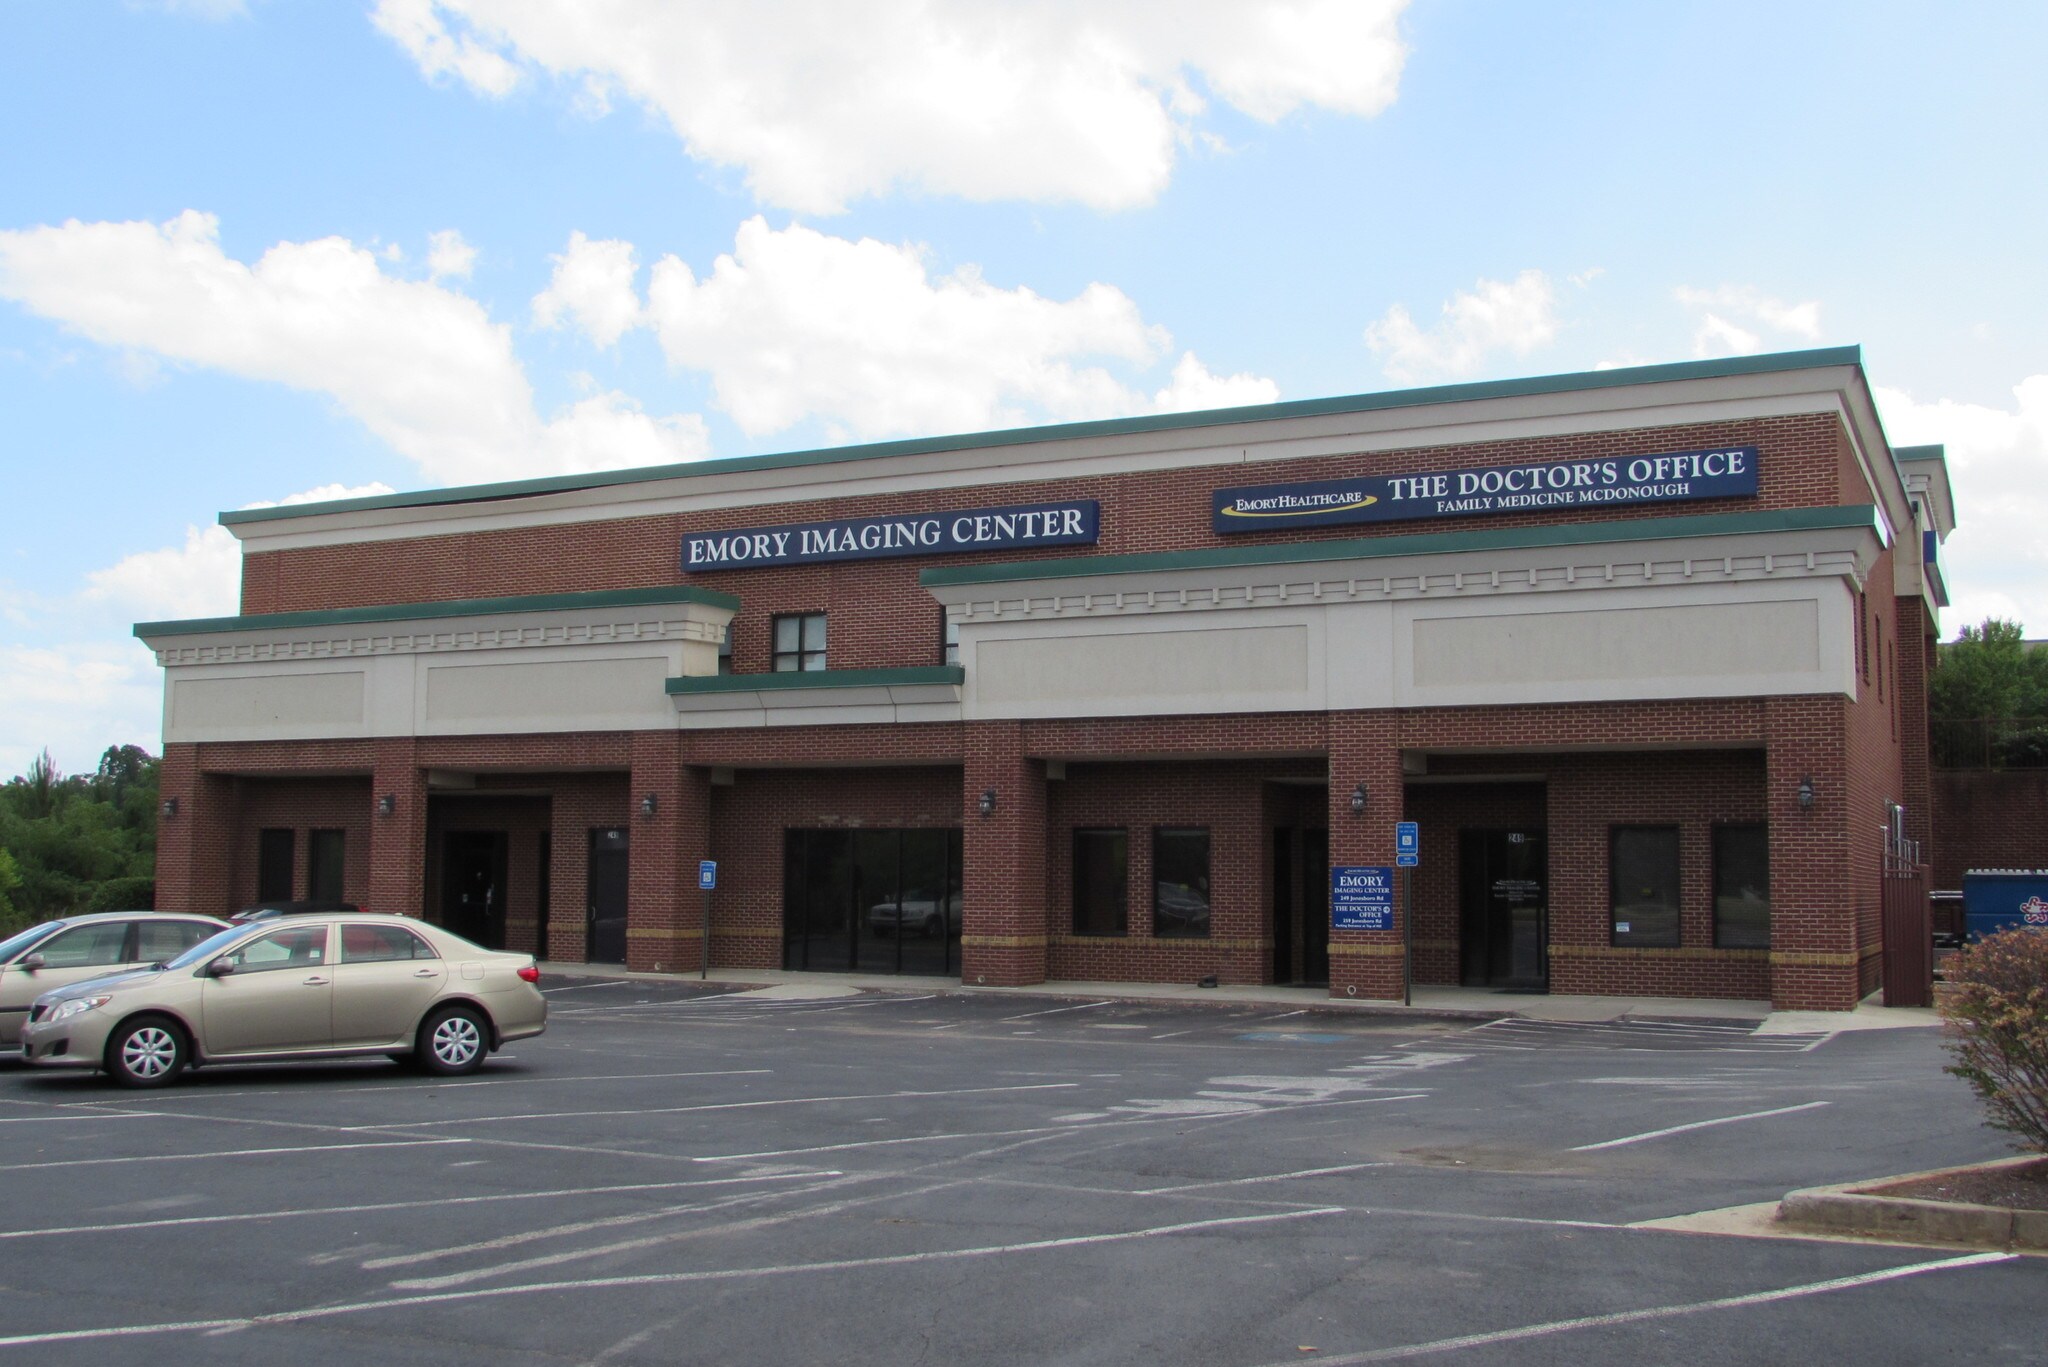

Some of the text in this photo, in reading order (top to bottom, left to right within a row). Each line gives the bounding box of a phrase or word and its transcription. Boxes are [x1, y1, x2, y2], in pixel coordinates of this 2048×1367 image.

[1387, 451, 1746, 500] THE DOCTOR'S OFFICE
[1436, 482, 1690, 513] FAMILY MEDICINE MCDONOUGH
[688, 509, 1085, 564] EMORY IMAGING CENTER
[1340, 876, 1384, 886] EMORY
